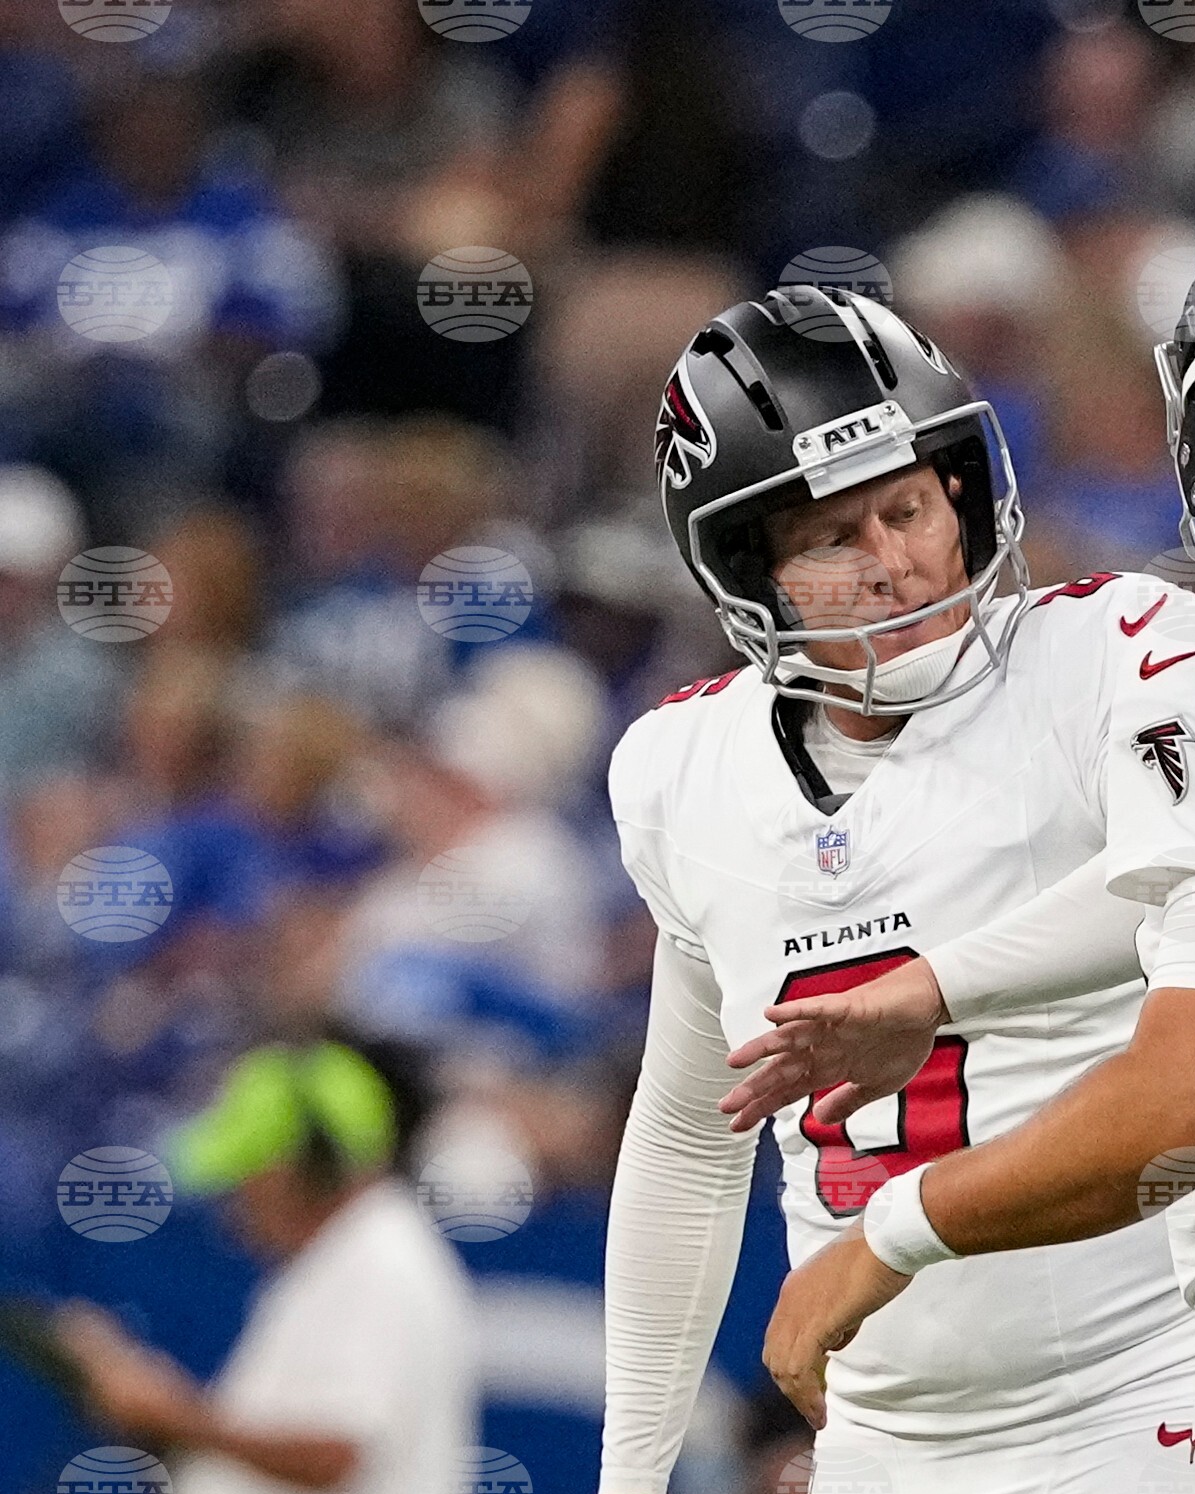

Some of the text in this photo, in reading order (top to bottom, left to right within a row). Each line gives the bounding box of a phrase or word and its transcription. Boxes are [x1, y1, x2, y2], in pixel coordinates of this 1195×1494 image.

[822, 417, 881, 453] ATL
[820, 848, 845, 870] NFL
[783, 911, 912, 957] ATLANTA
